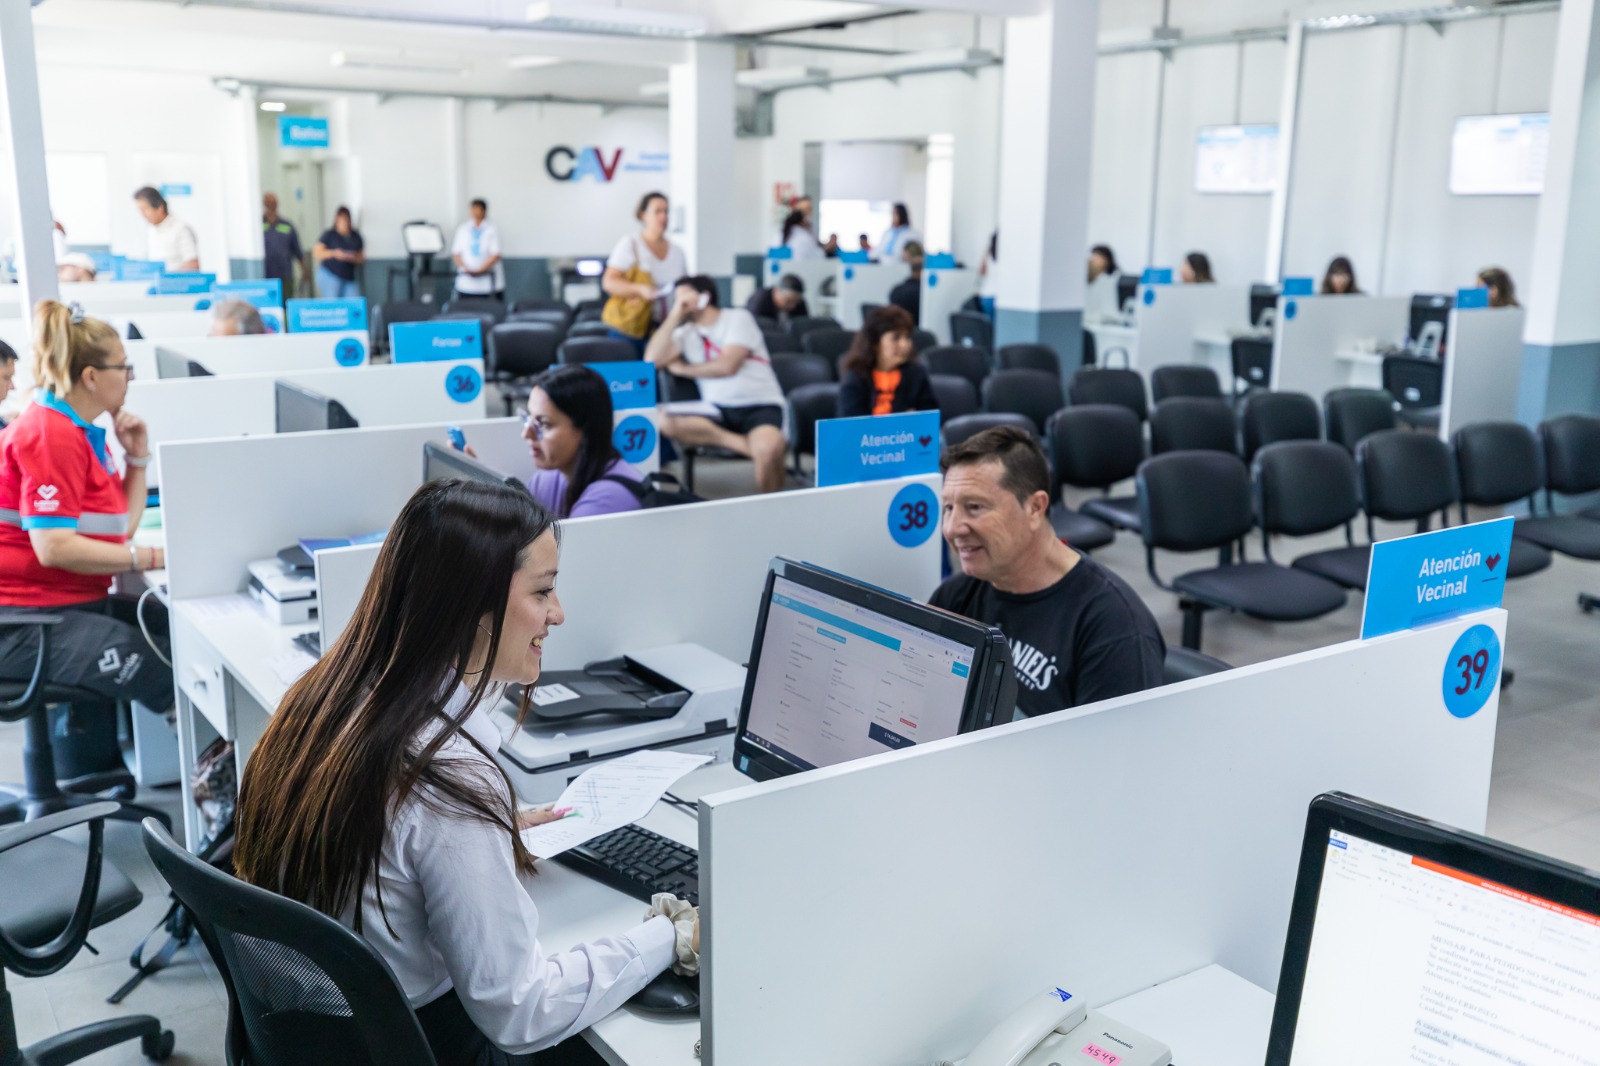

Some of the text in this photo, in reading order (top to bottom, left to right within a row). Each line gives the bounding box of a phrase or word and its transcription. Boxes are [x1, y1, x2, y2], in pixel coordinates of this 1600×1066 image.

[545, 146, 623, 182] CAV
[453, 374, 475, 393] 36
[623, 429, 647, 451] 37
[860, 430, 914, 447] Atención
[860, 449, 905, 466] Vecinal
[900, 500, 928, 531] 38
[1418, 548, 1481, 578] Atención
[1416, 575, 1468, 604] Vecinal
[1455, 648, 1489, 695] 39
[1102, 1031, 1134, 1050] Panasonic
[1422, 1023, 1442, 1034] cargo
[1452, 1033, 1473, 1047] Redes
[1087, 1045, 1117, 1064] 4549
